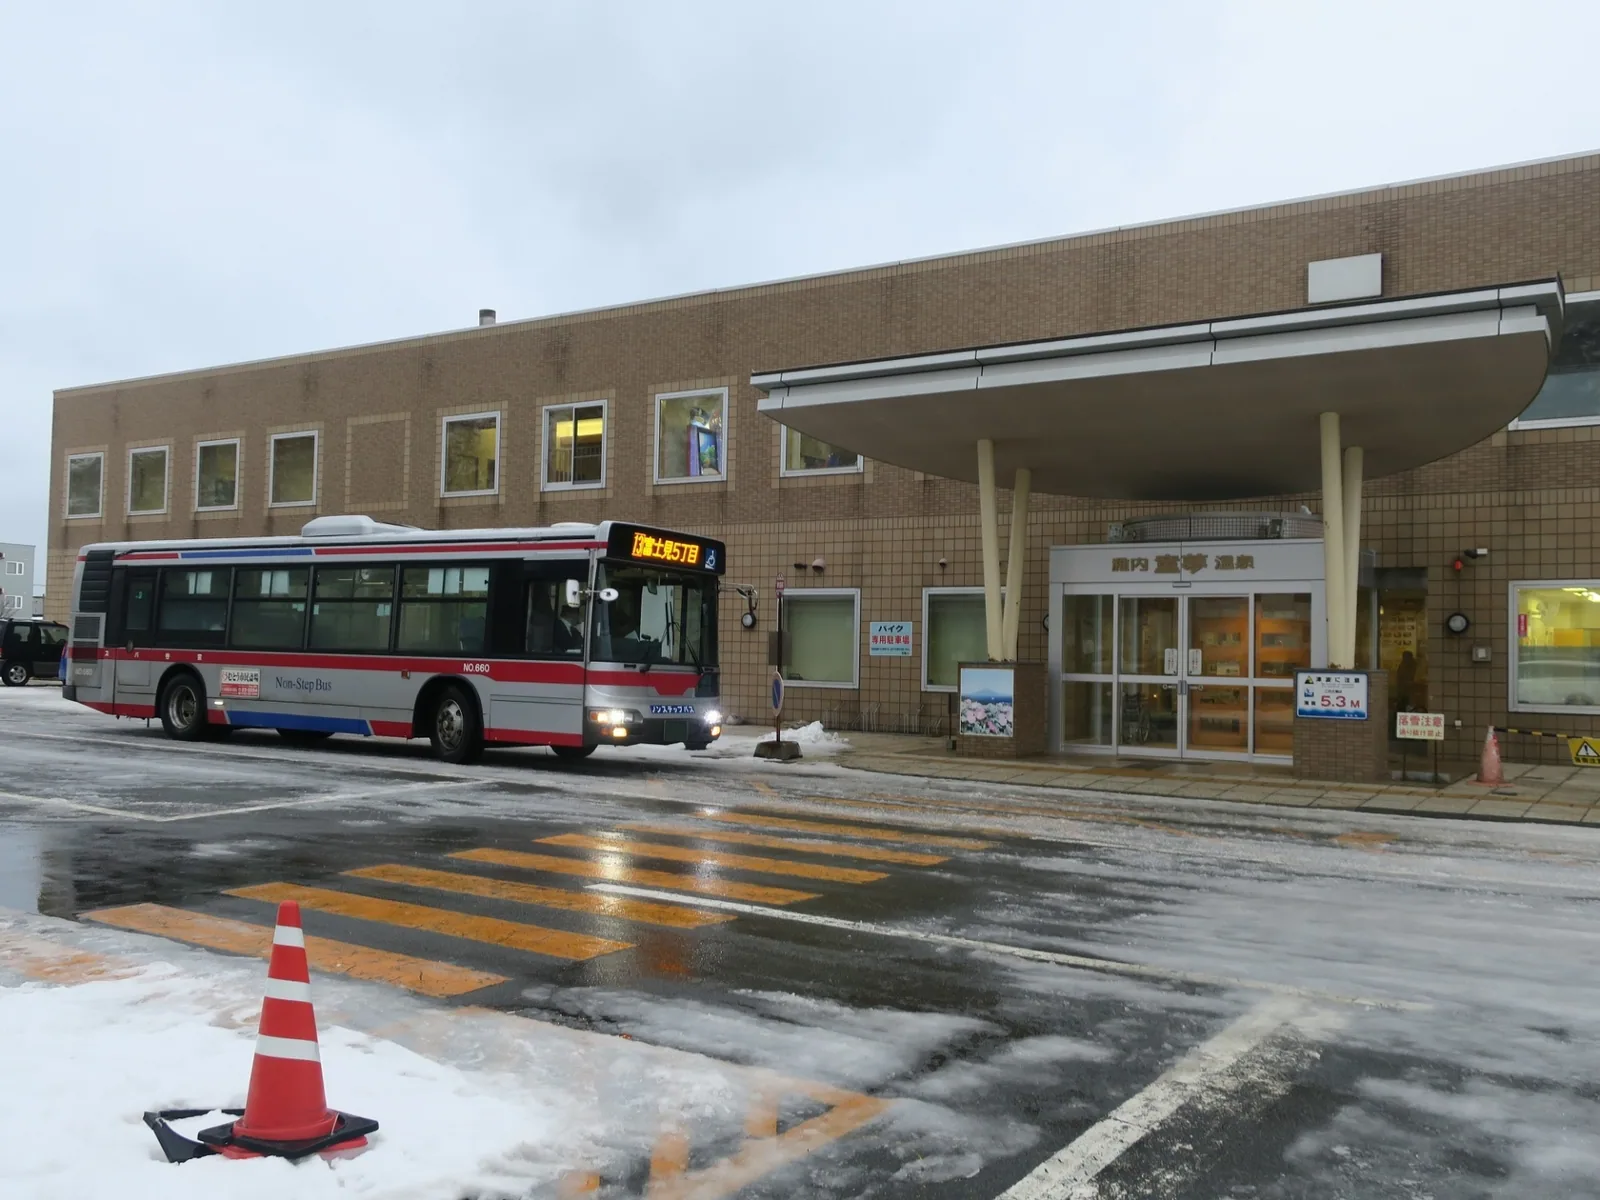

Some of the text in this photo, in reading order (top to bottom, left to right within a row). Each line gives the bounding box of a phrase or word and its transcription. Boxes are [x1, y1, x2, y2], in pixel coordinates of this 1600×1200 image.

[879, 625, 904, 633] バイク
[872, 634, 910, 645] 専用駐車場
[275, 676, 314, 693] Non-Step
[315, 678, 332, 691] Bus
[1320, 695, 1346, 708] 5.3
[1350, 700, 1360, 708] M
[652, 705, 695, 713] ノンステップバス
